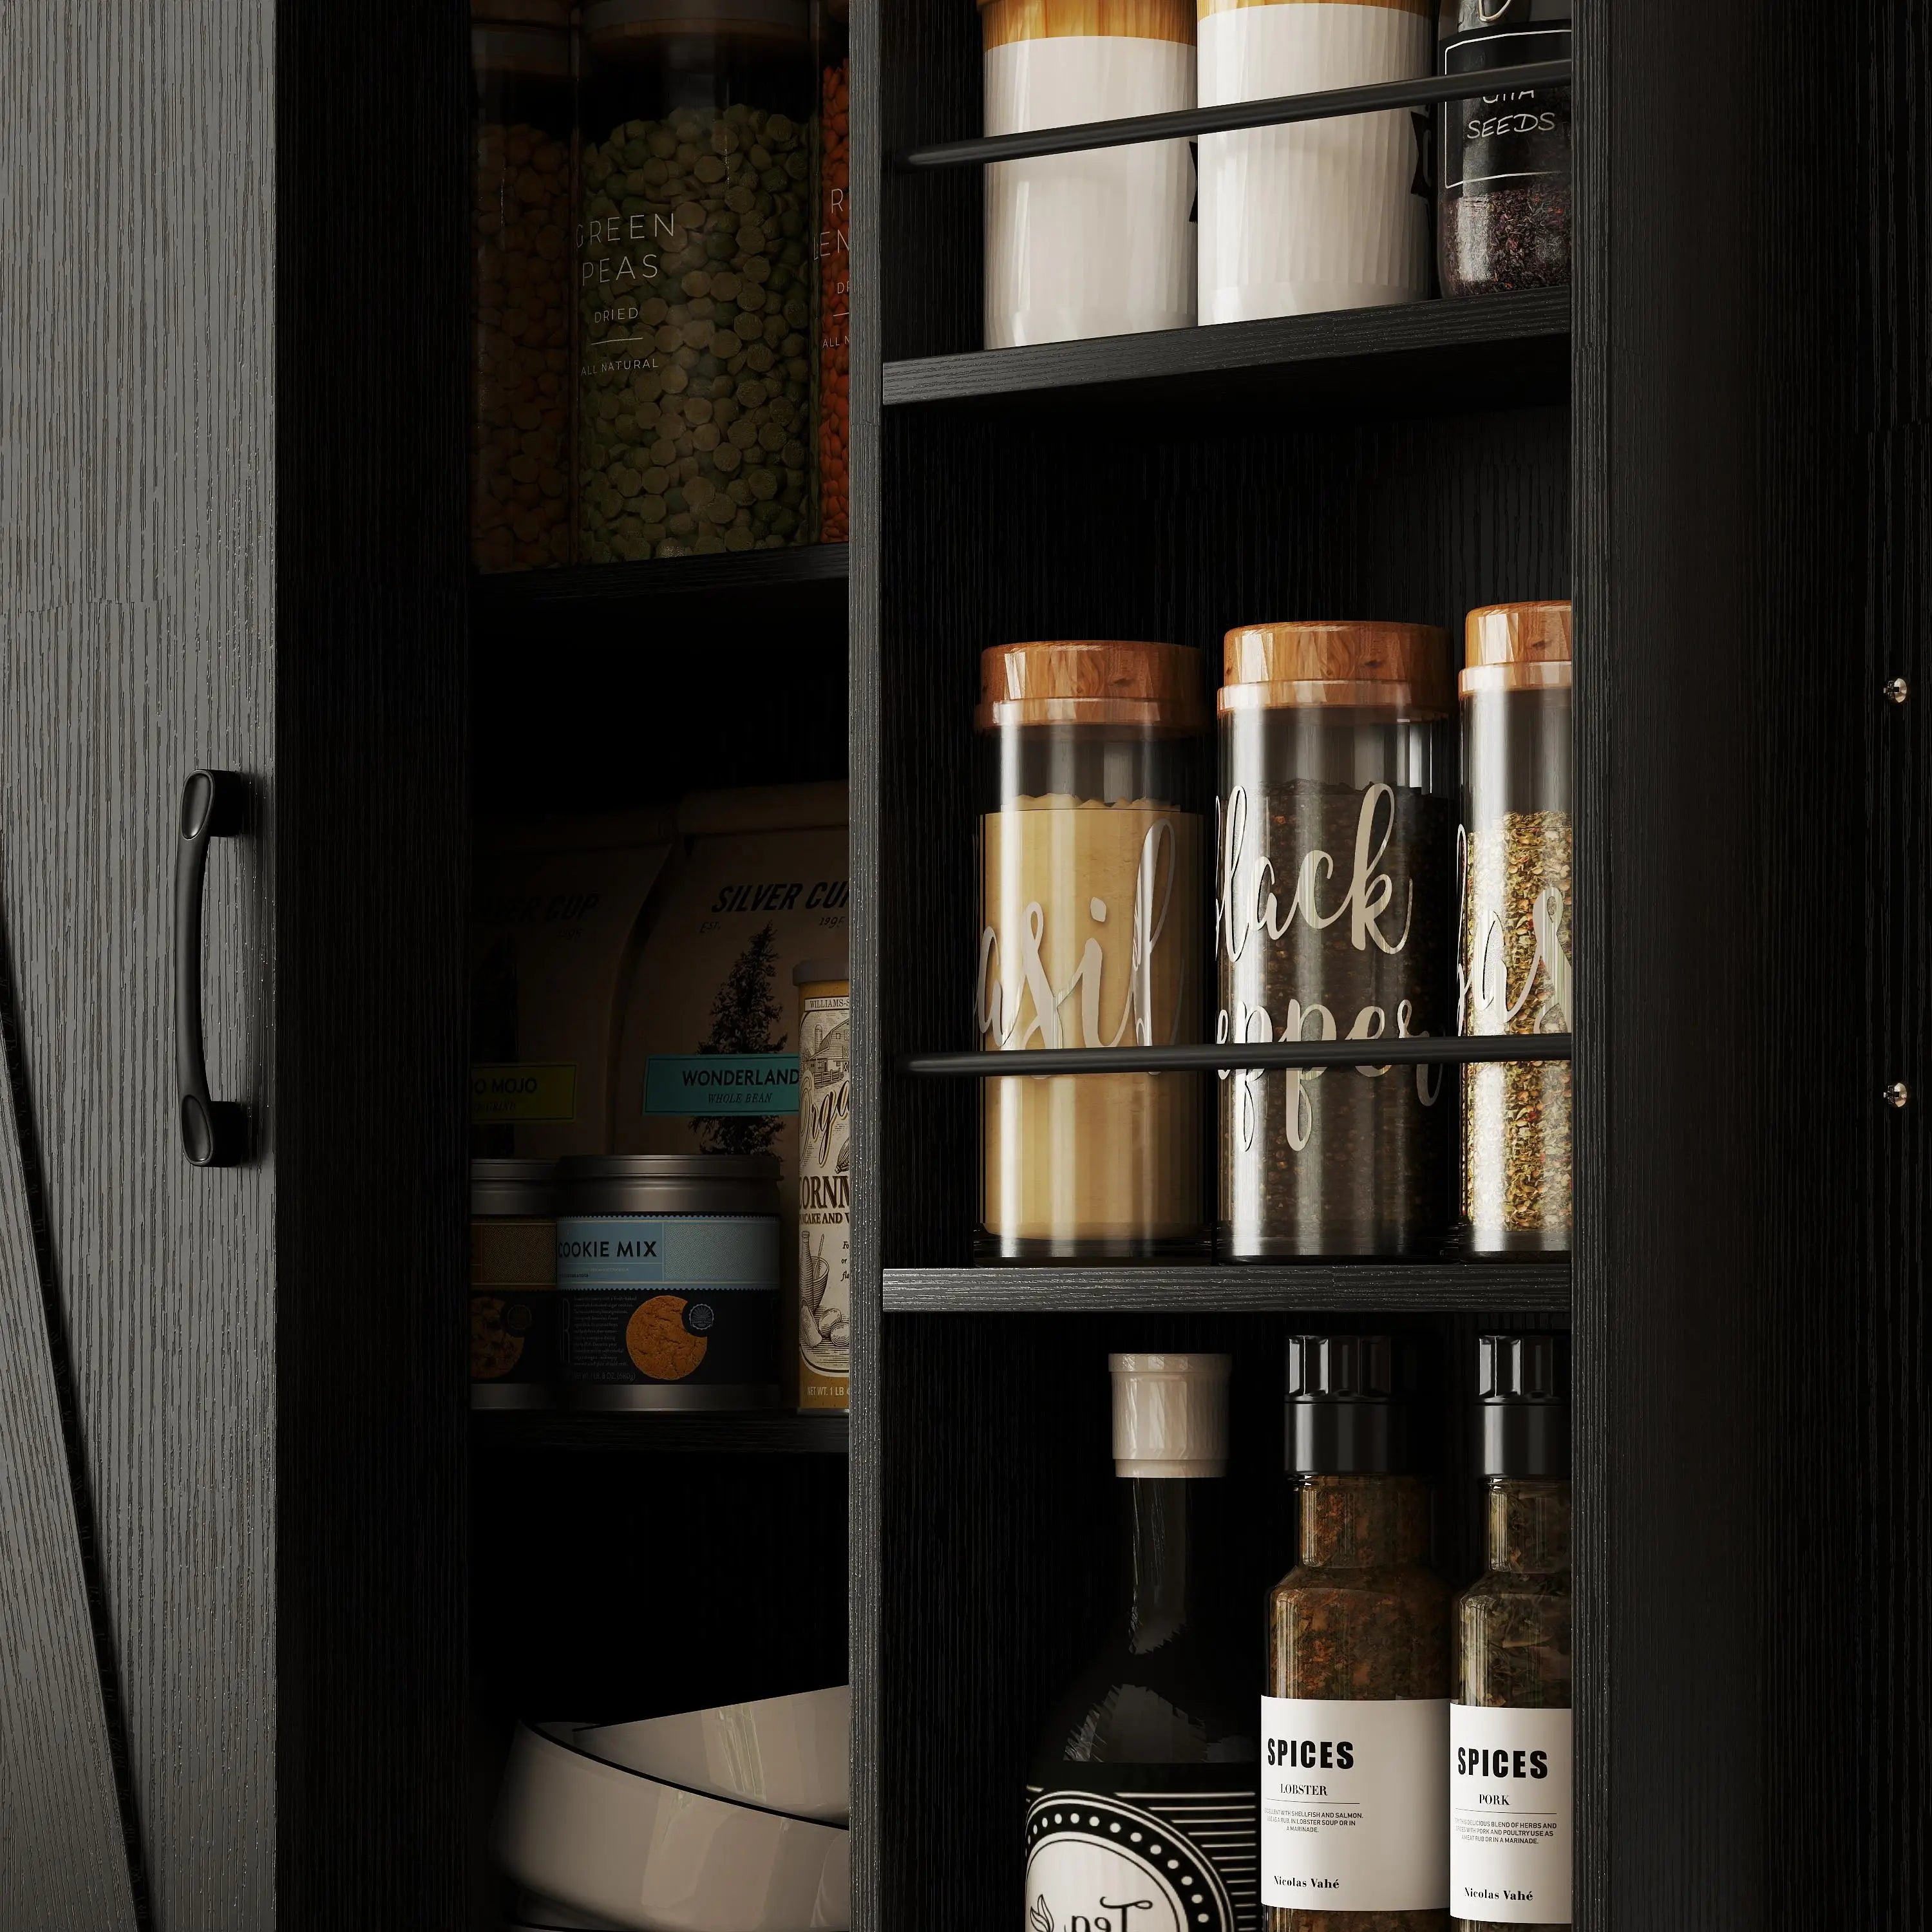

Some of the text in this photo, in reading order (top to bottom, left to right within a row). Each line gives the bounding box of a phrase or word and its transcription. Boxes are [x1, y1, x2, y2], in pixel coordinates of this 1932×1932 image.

[1467, 112, 1556, 139] SEEDS
[576, 213, 674, 249] GREEN
[582, 254, 658, 288] PEAS
[594, 307, 638, 323] DRIED
[822, 336, 840, 349] ALL
[581, 358, 659, 377] ALL NATURAL
[711, 883, 803, 913] SILVER
[492, 1077, 538, 1094] MOJO
[682, 1069, 799, 1086] WONDERLAND
[708, 1092, 773, 1104] WHOLE BEAN
[822, 1213, 842, 1224] AND
[558, 1241, 657, 1258] COOKIE MIX
[807, 1387, 816, 1396] NET
[817, 1387, 828, 1396] WT.
[829, 1387, 833, 1396] 1
[835, 1387, 844, 1396] LB
[1267, 1738, 1354, 1770] SPICES
[1457, 1747, 1548, 1779] SPICES
[1280, 1783, 1328, 1796] LOBSTER
[1479, 1794, 1510, 1806] PORK
[1273, 1875, 1340, 1889] Nicolas Vahé
[1464, 1887, 1533, 1902] Nicolas Vahé
